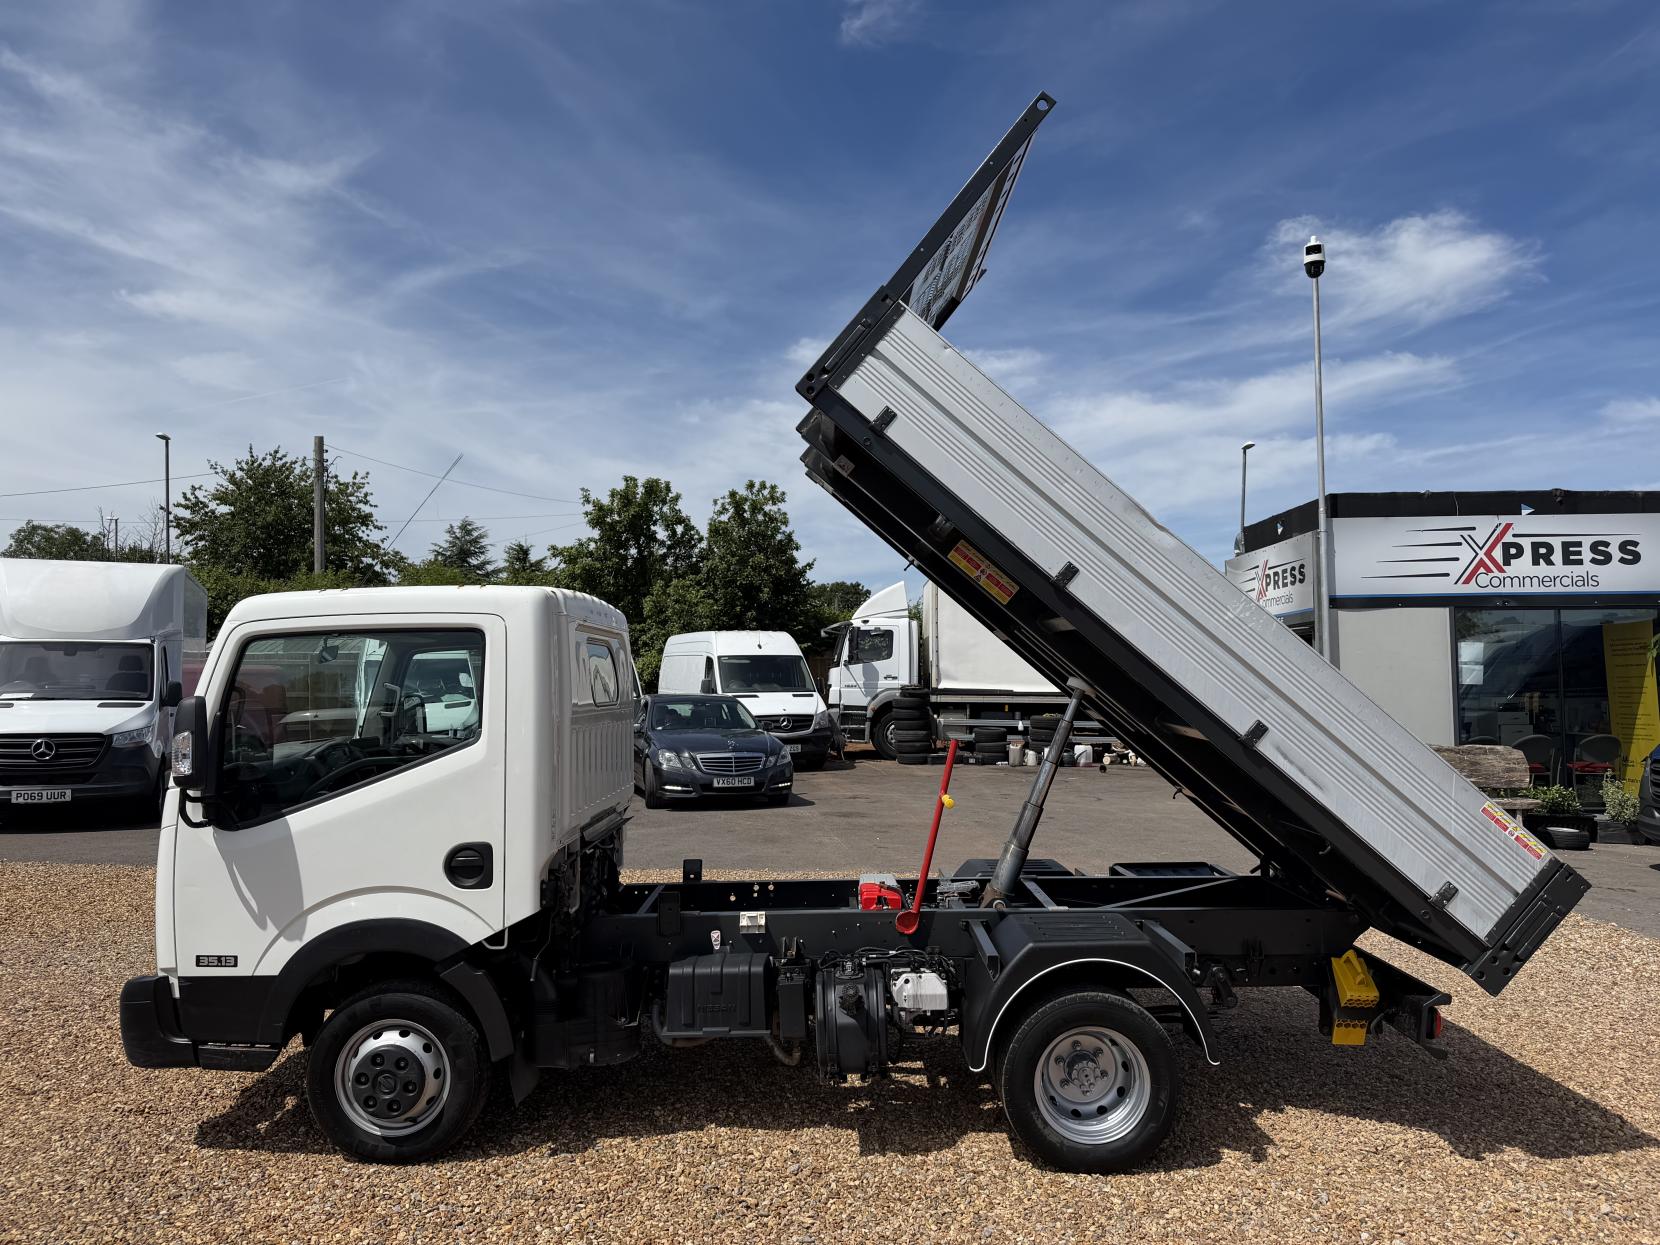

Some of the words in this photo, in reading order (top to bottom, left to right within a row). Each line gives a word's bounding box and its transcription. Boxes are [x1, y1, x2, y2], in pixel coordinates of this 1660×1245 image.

[1453, 522, 1642, 585] XPRESS
[1255, 559, 1306, 602] XPRESS
[1475, 570, 1600, 588] Commercials
[716, 778, 736, 787] VX60
[737, 777, 752, 785] HCD
[16, 792, 44, 801] PO69
[46, 791, 67, 800] UUR
[199, 956, 235, 966] 35.13
